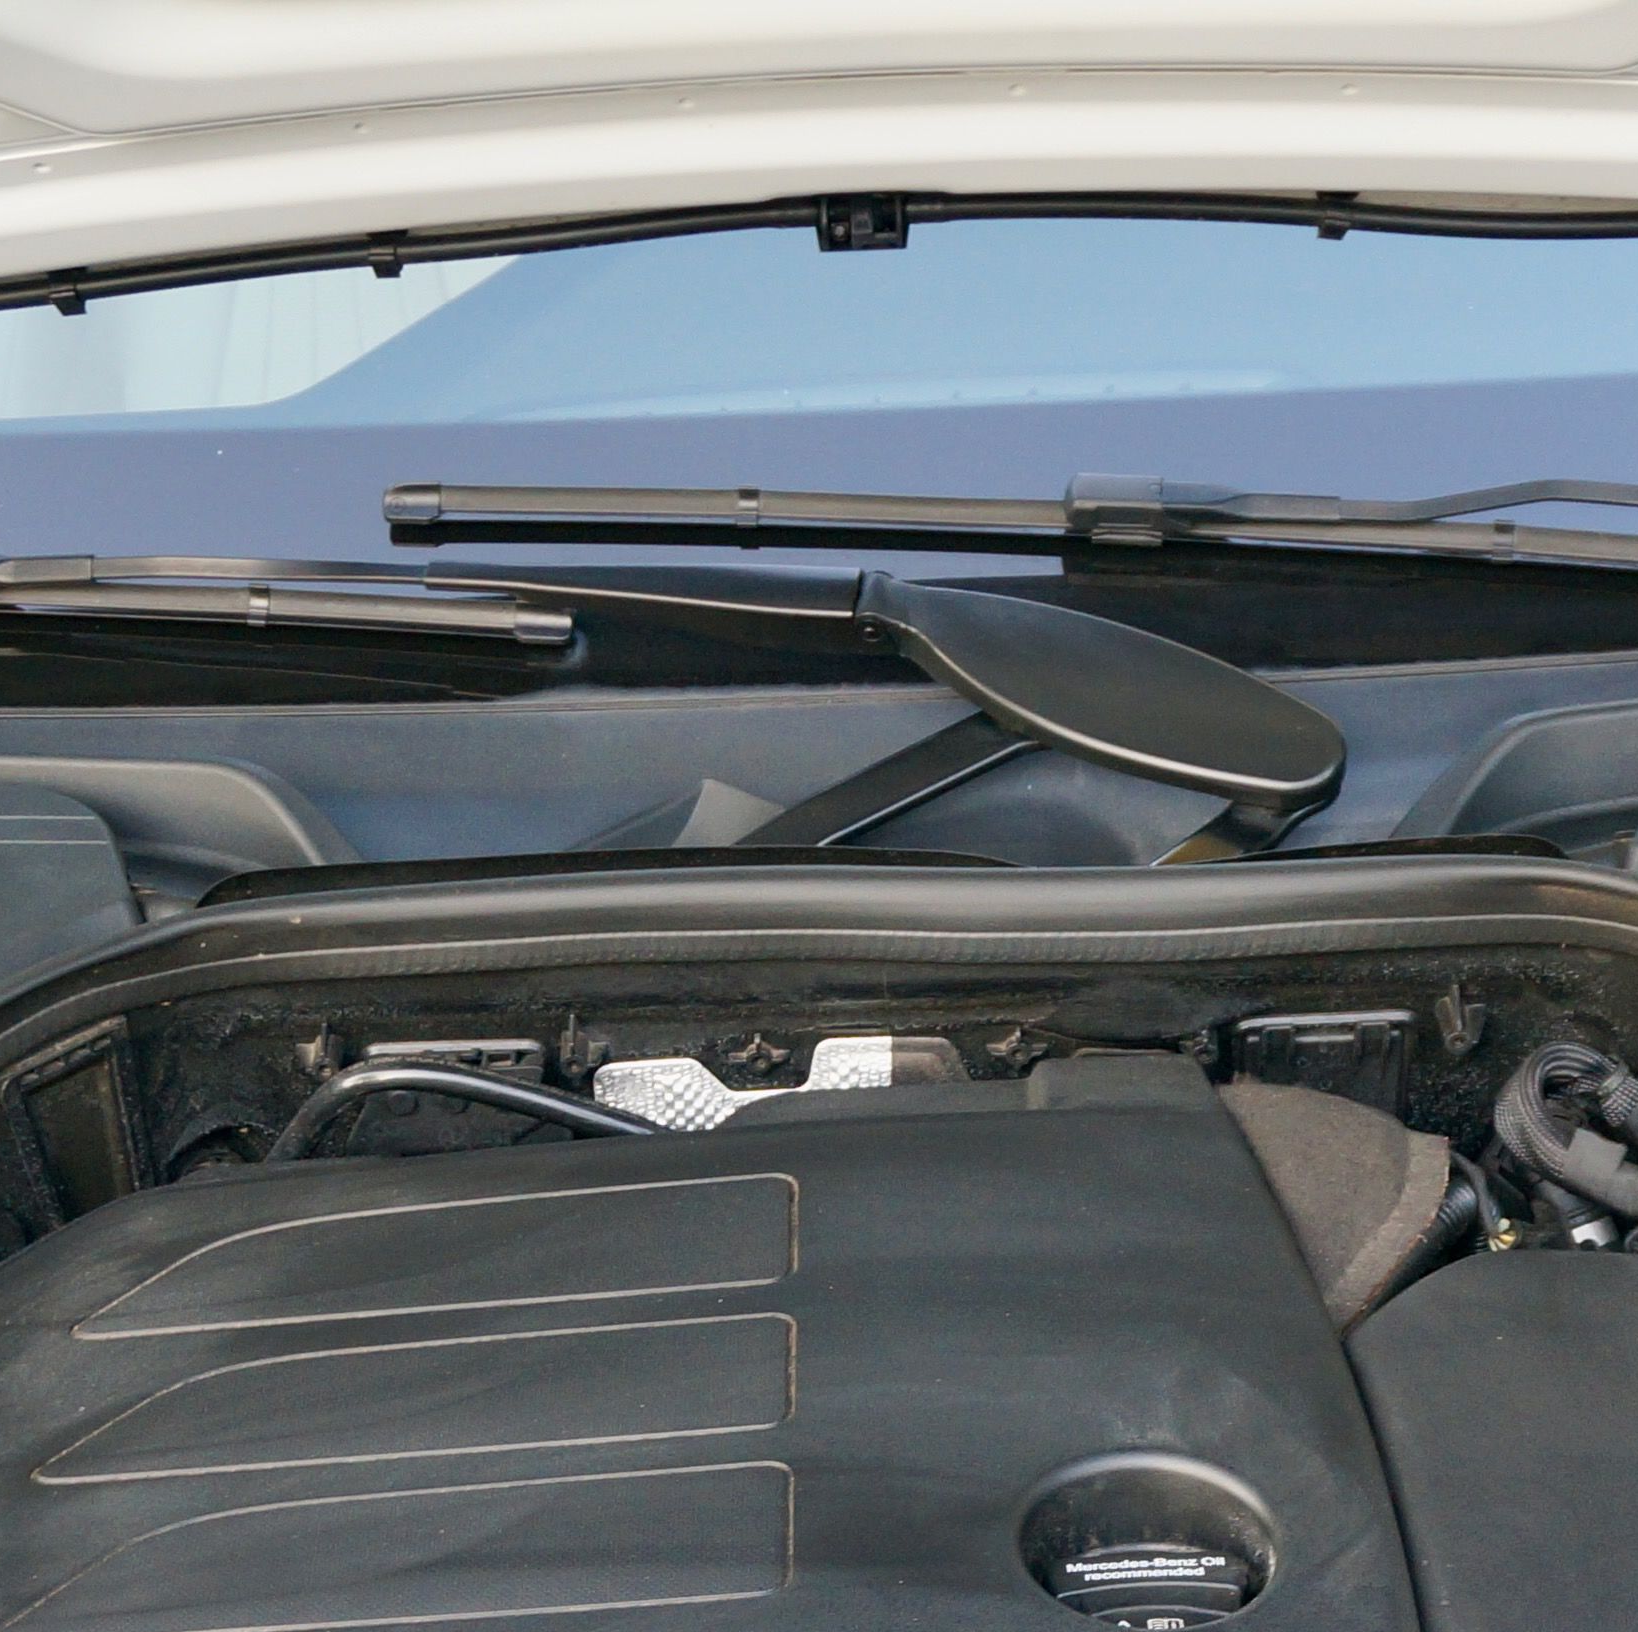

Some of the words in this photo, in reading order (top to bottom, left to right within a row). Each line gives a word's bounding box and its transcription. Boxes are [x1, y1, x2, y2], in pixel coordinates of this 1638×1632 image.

[1066, 1558, 1198, 1573] Mercedes-Benz
[1200, 1556, 1226, 1566] Oil
[1084, 1567, 1205, 1581] recommended
